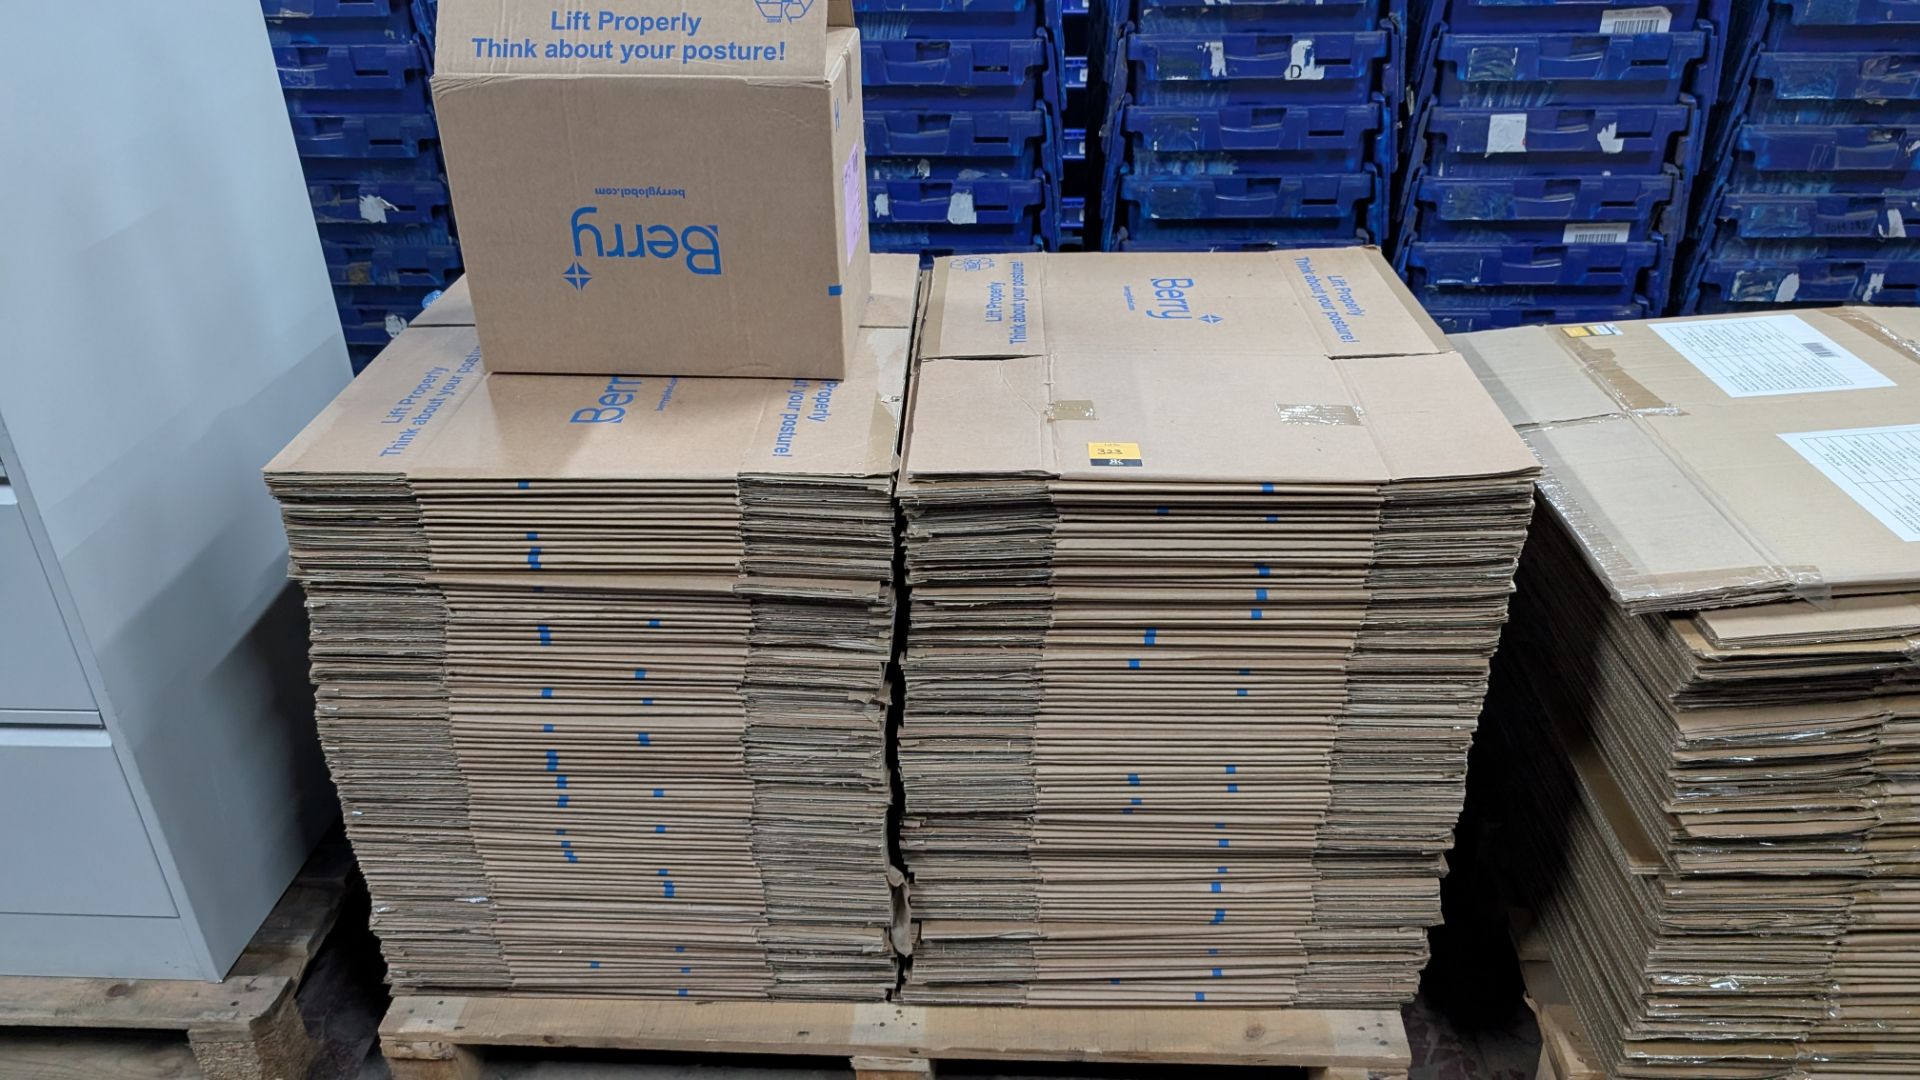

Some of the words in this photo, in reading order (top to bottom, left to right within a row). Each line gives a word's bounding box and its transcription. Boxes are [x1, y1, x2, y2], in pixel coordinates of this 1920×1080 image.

[551, 11, 591, 31] Lift
[598, 12, 702, 35] Properly
[472, 38, 537, 59] Think
[545, 38, 613, 60] about
[620, 42, 674, 63] your
[682, 40, 786, 63] posture!
[1290, 64, 1302, 79] D
[594, 187, 686, 200] berryglobal.com
[570, 206, 722, 275] Berry
[1009, 261, 1028, 287] posture!
[1295, 256, 1316, 275] Think
[1304, 274, 1328, 294] about
[1327, 274, 1347, 287] Lift
[986, 281, 1006, 309] Properly
[1012, 287, 1029, 302] your
[1146, 278, 1195, 319] Berry
[1312, 293, 1336, 310] your
[1336, 287, 1366, 317] Properly
[985, 309, 1003, 323] Lift
[1009, 303, 1026, 323] about
[1009, 324, 1028, 345] Think
[1322, 311, 1360, 343] posture!
[380, 407, 413, 424] Lift
[398, 366, 450, 405] Properly
[569, 375, 642, 424] Berr
[784, 389, 805, 412] your
[806, 380, 839, 422] Properly
[379, 427, 422, 457] Think
[411, 397, 447, 425] about
[437, 375, 464, 396] your
[772, 413, 800, 457] posture!
